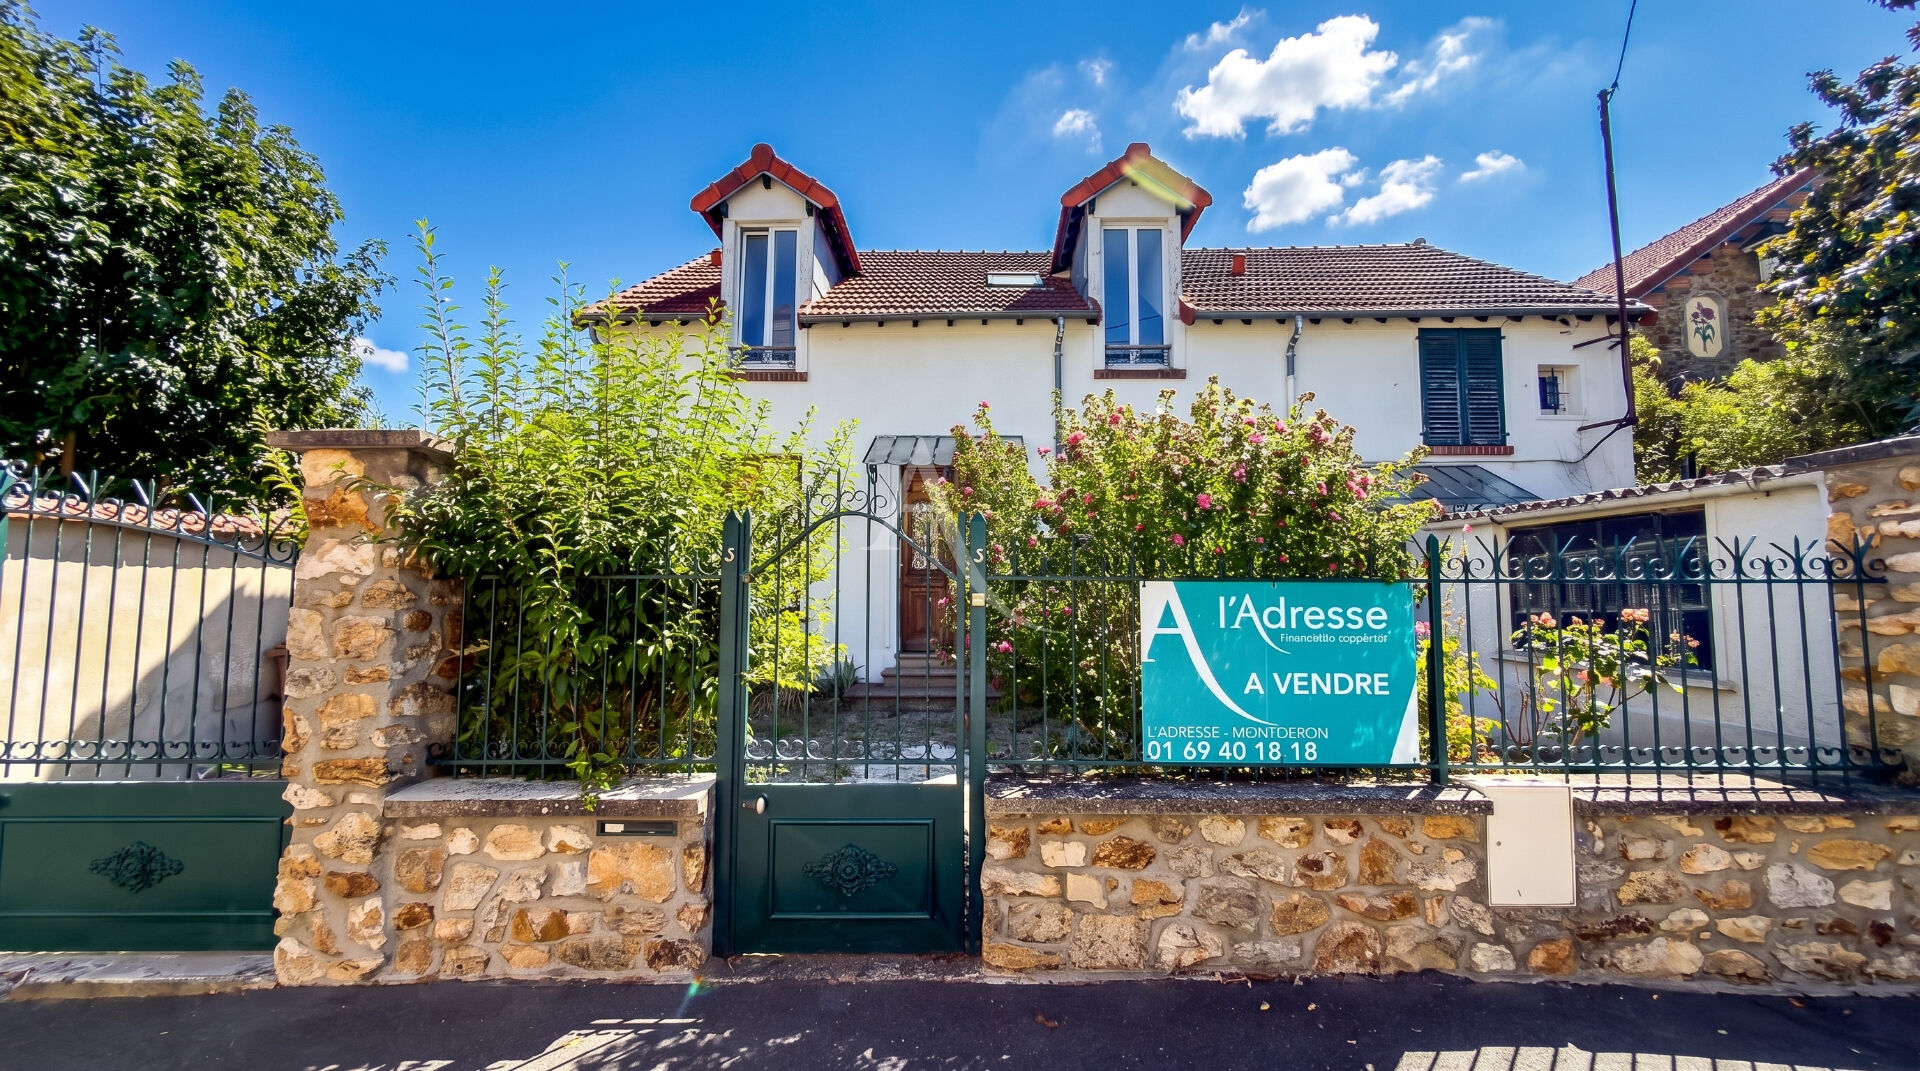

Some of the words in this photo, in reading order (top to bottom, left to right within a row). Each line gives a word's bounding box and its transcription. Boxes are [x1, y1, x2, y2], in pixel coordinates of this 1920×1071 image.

[1219, 593, 1388, 655] l'Adresse
[1243, 673, 1265, 695] A
[1272, 672, 1390, 696] VENDRE
[1147, 726, 1220, 739] L'ADRESSE
[1148, 741, 1173, 760] 01
[1183, 741, 1211, 761] 69
[1218, 741, 1247, 761] 40
[1255, 741, 1282, 761] 18
[1291, 742, 1318, 761] 18
